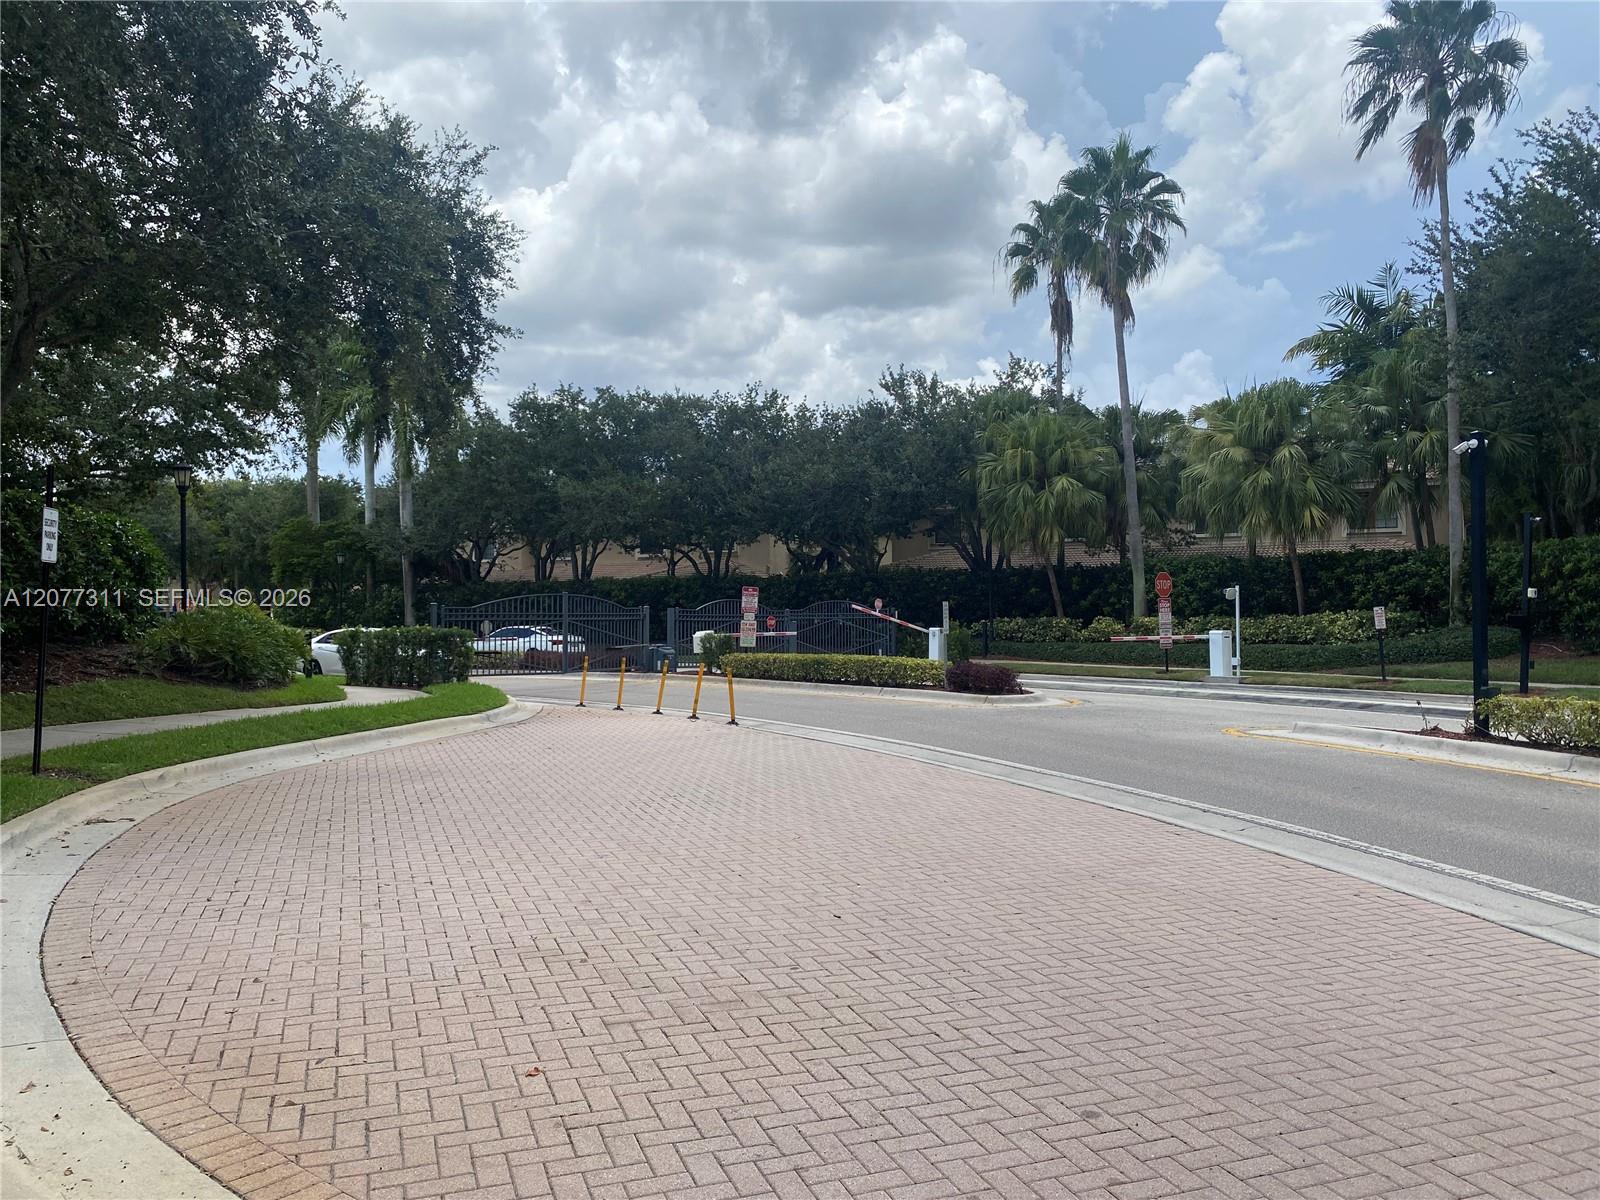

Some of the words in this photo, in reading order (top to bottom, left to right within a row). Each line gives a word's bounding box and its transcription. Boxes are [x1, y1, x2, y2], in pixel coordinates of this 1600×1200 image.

[44, 518, 57, 528] SECURITY
[44, 530, 57, 540] PARKING
[46, 543, 54, 551] ONLY
[1156, 580, 1171, 590] STOP
